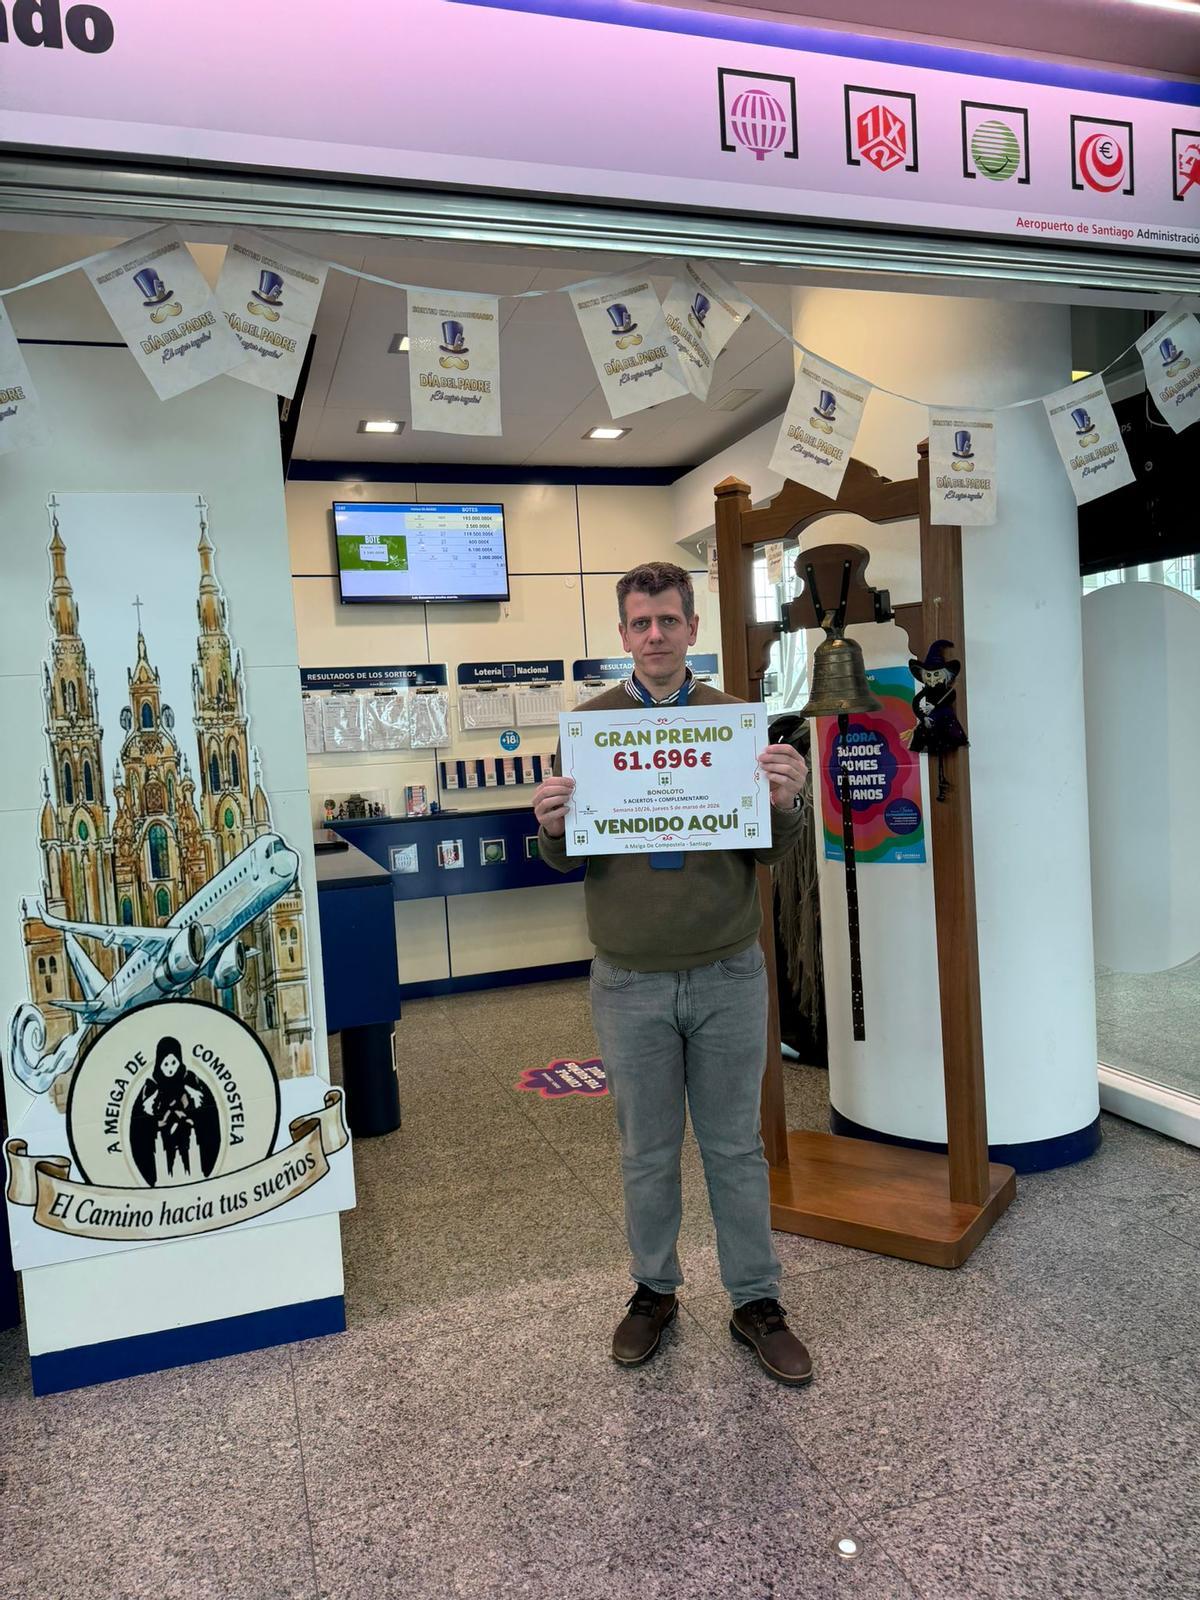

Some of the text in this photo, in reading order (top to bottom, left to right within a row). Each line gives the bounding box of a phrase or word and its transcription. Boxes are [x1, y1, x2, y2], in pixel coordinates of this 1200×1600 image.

[1016, 217, 1074, 232] Aeropuerto
[1076, 222, 1089, 234] de
[1092, 224, 1134, 240] Santiago
[140, 311, 216, 354] DÍA DEL PADRE
[242, 321, 260, 338] DEL
[260, 327, 297, 352] PADRE
[604, 358, 624, 376] DÍA
[624, 355, 639, 370] DEL
[637, 345, 669, 365] PADRE
[420, 372, 491, 393] DÍA DEL PADRE
[1159, 377, 1190, 402] DÍA DEL
[0, 386, 26, 404] DRE
[787, 425, 844, 461] DÍA DEL PADRE
[365, 536, 380, 544] BOTE
[307, 672, 355, 681] RESULTADOS
[369, 671, 383, 679] LOS
[384, 670, 417, 678] SORTEOS
[474, 665, 549, 676] Lotería Nacional
[594, 726, 733, 747] GRAN PREMIO
[839, 732, 877, 743] GORA
[855, 759, 879, 771] MES
[837, 774, 886, 786] DRANTE
[658, 795, 709, 803] COMPLEMENTARIO
[853, 788, 884, 800] ANOS
[594, 807, 739, 835] VENDIDO AQUÍ
[654, 841, 685, 849] Compostela
[104, 1044, 246, 1155] A MEIGA DE COMPOSTELA
[49, 1153, 316, 1228] El Camino hacia tus sueños
